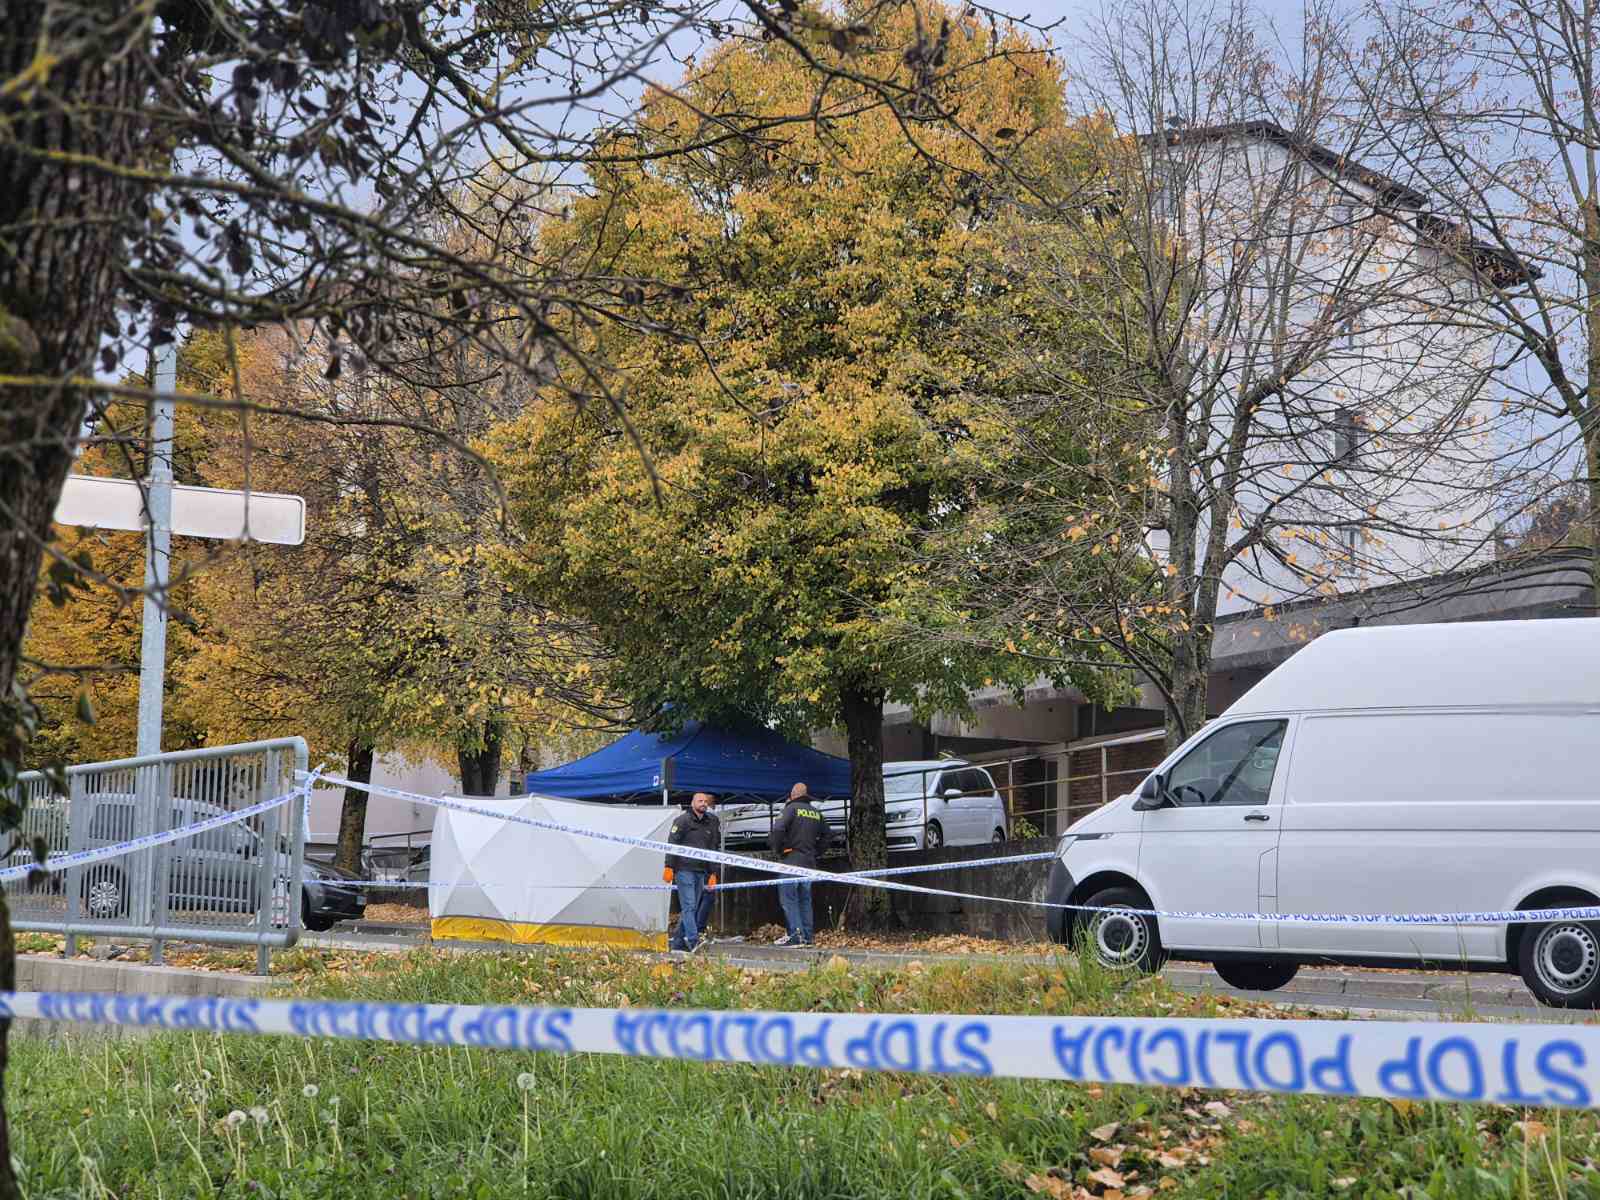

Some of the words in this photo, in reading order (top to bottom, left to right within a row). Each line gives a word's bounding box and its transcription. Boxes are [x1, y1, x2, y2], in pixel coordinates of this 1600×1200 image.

[1351, 912, 1382, 922] STOP
[1385, 912, 1438, 922] POLICIJA
[1441, 912, 1471, 922] STOP
[1474, 912, 1526, 921] POLICIJA
[1530, 910, 1559, 920] STOP
[613, 1010, 837, 1068] POLICIJA
[845, 1019, 994, 1075] STOP
[1052, 1024, 1361, 1095] POLICIJA
[1377, 1035, 1592, 1106] STOP
